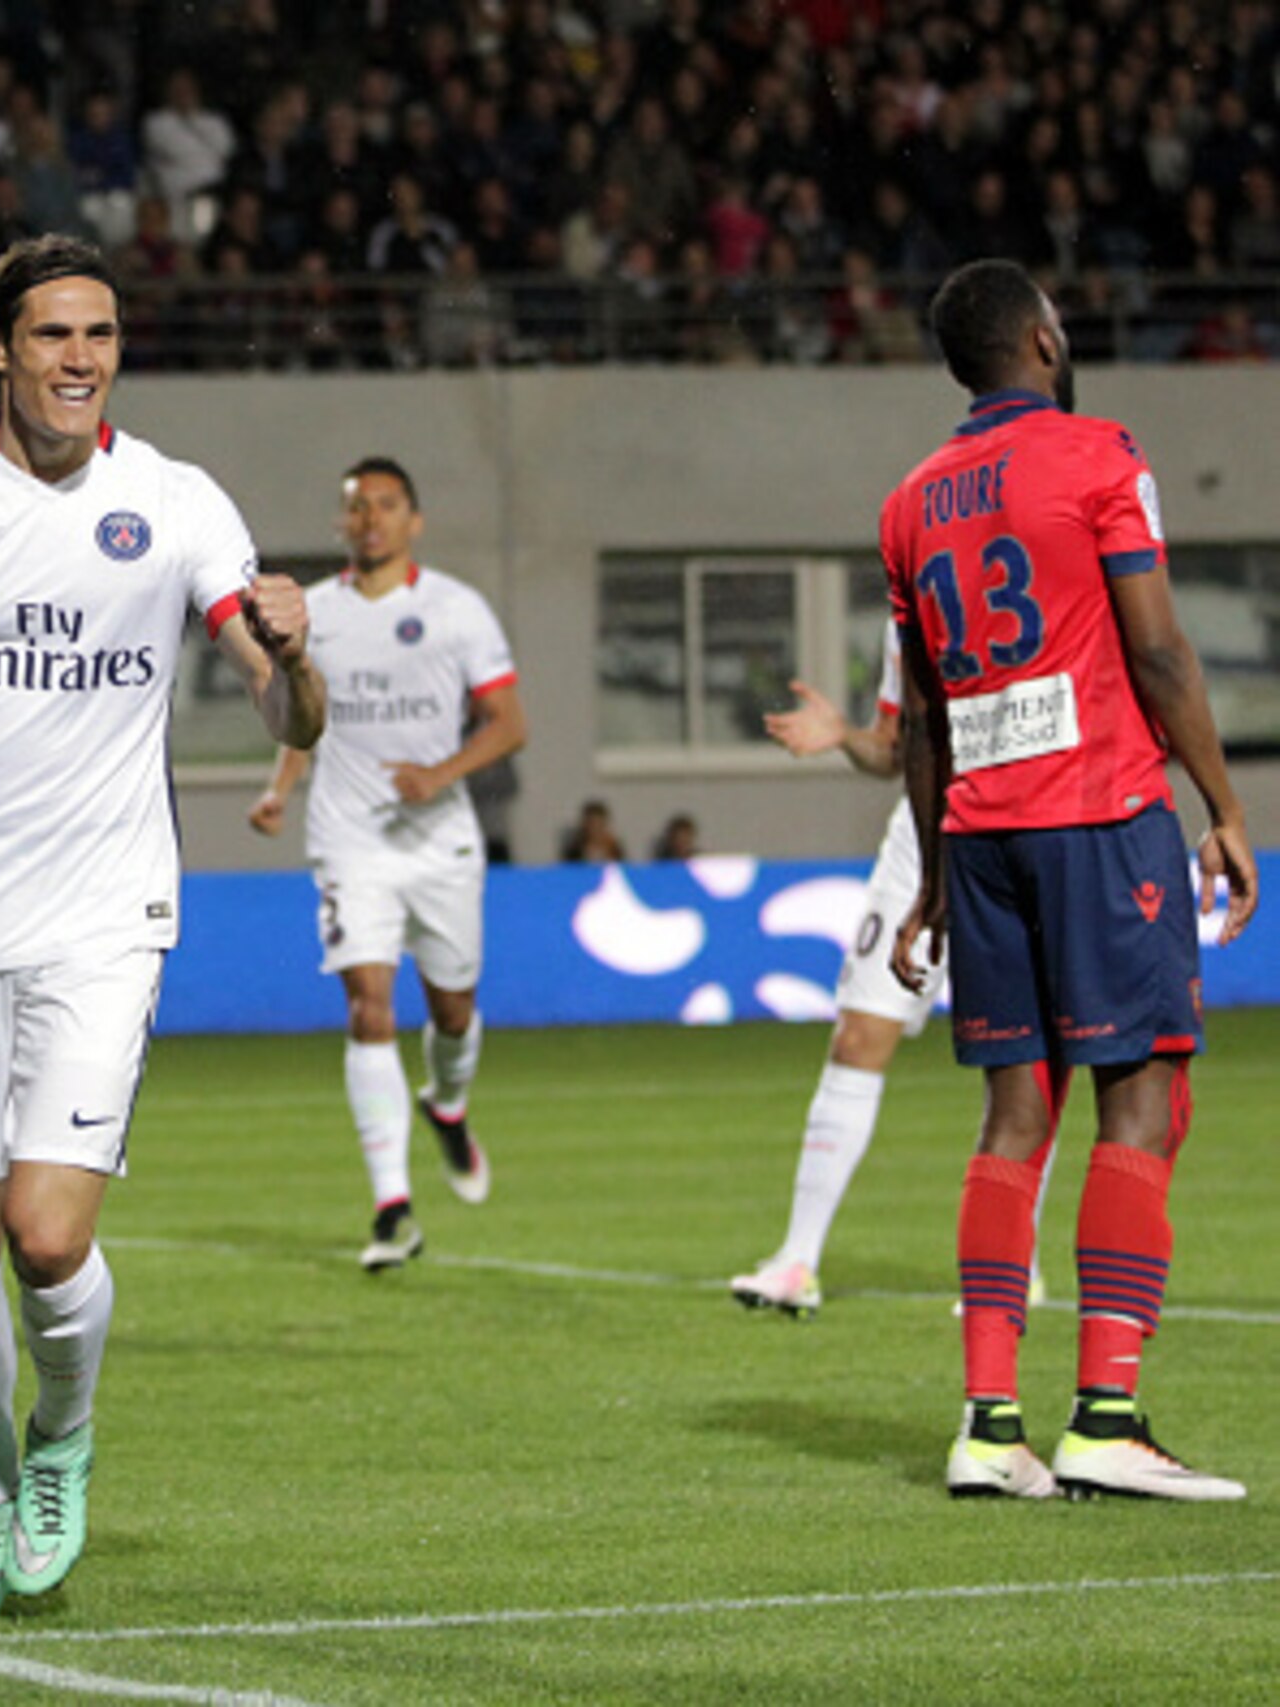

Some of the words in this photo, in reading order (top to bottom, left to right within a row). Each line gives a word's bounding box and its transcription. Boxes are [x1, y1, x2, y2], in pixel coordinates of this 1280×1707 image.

[17, 603, 83, 643] Fly
[916, 535, 1045, 681] 13
[329, 697, 442, 725] mirates
